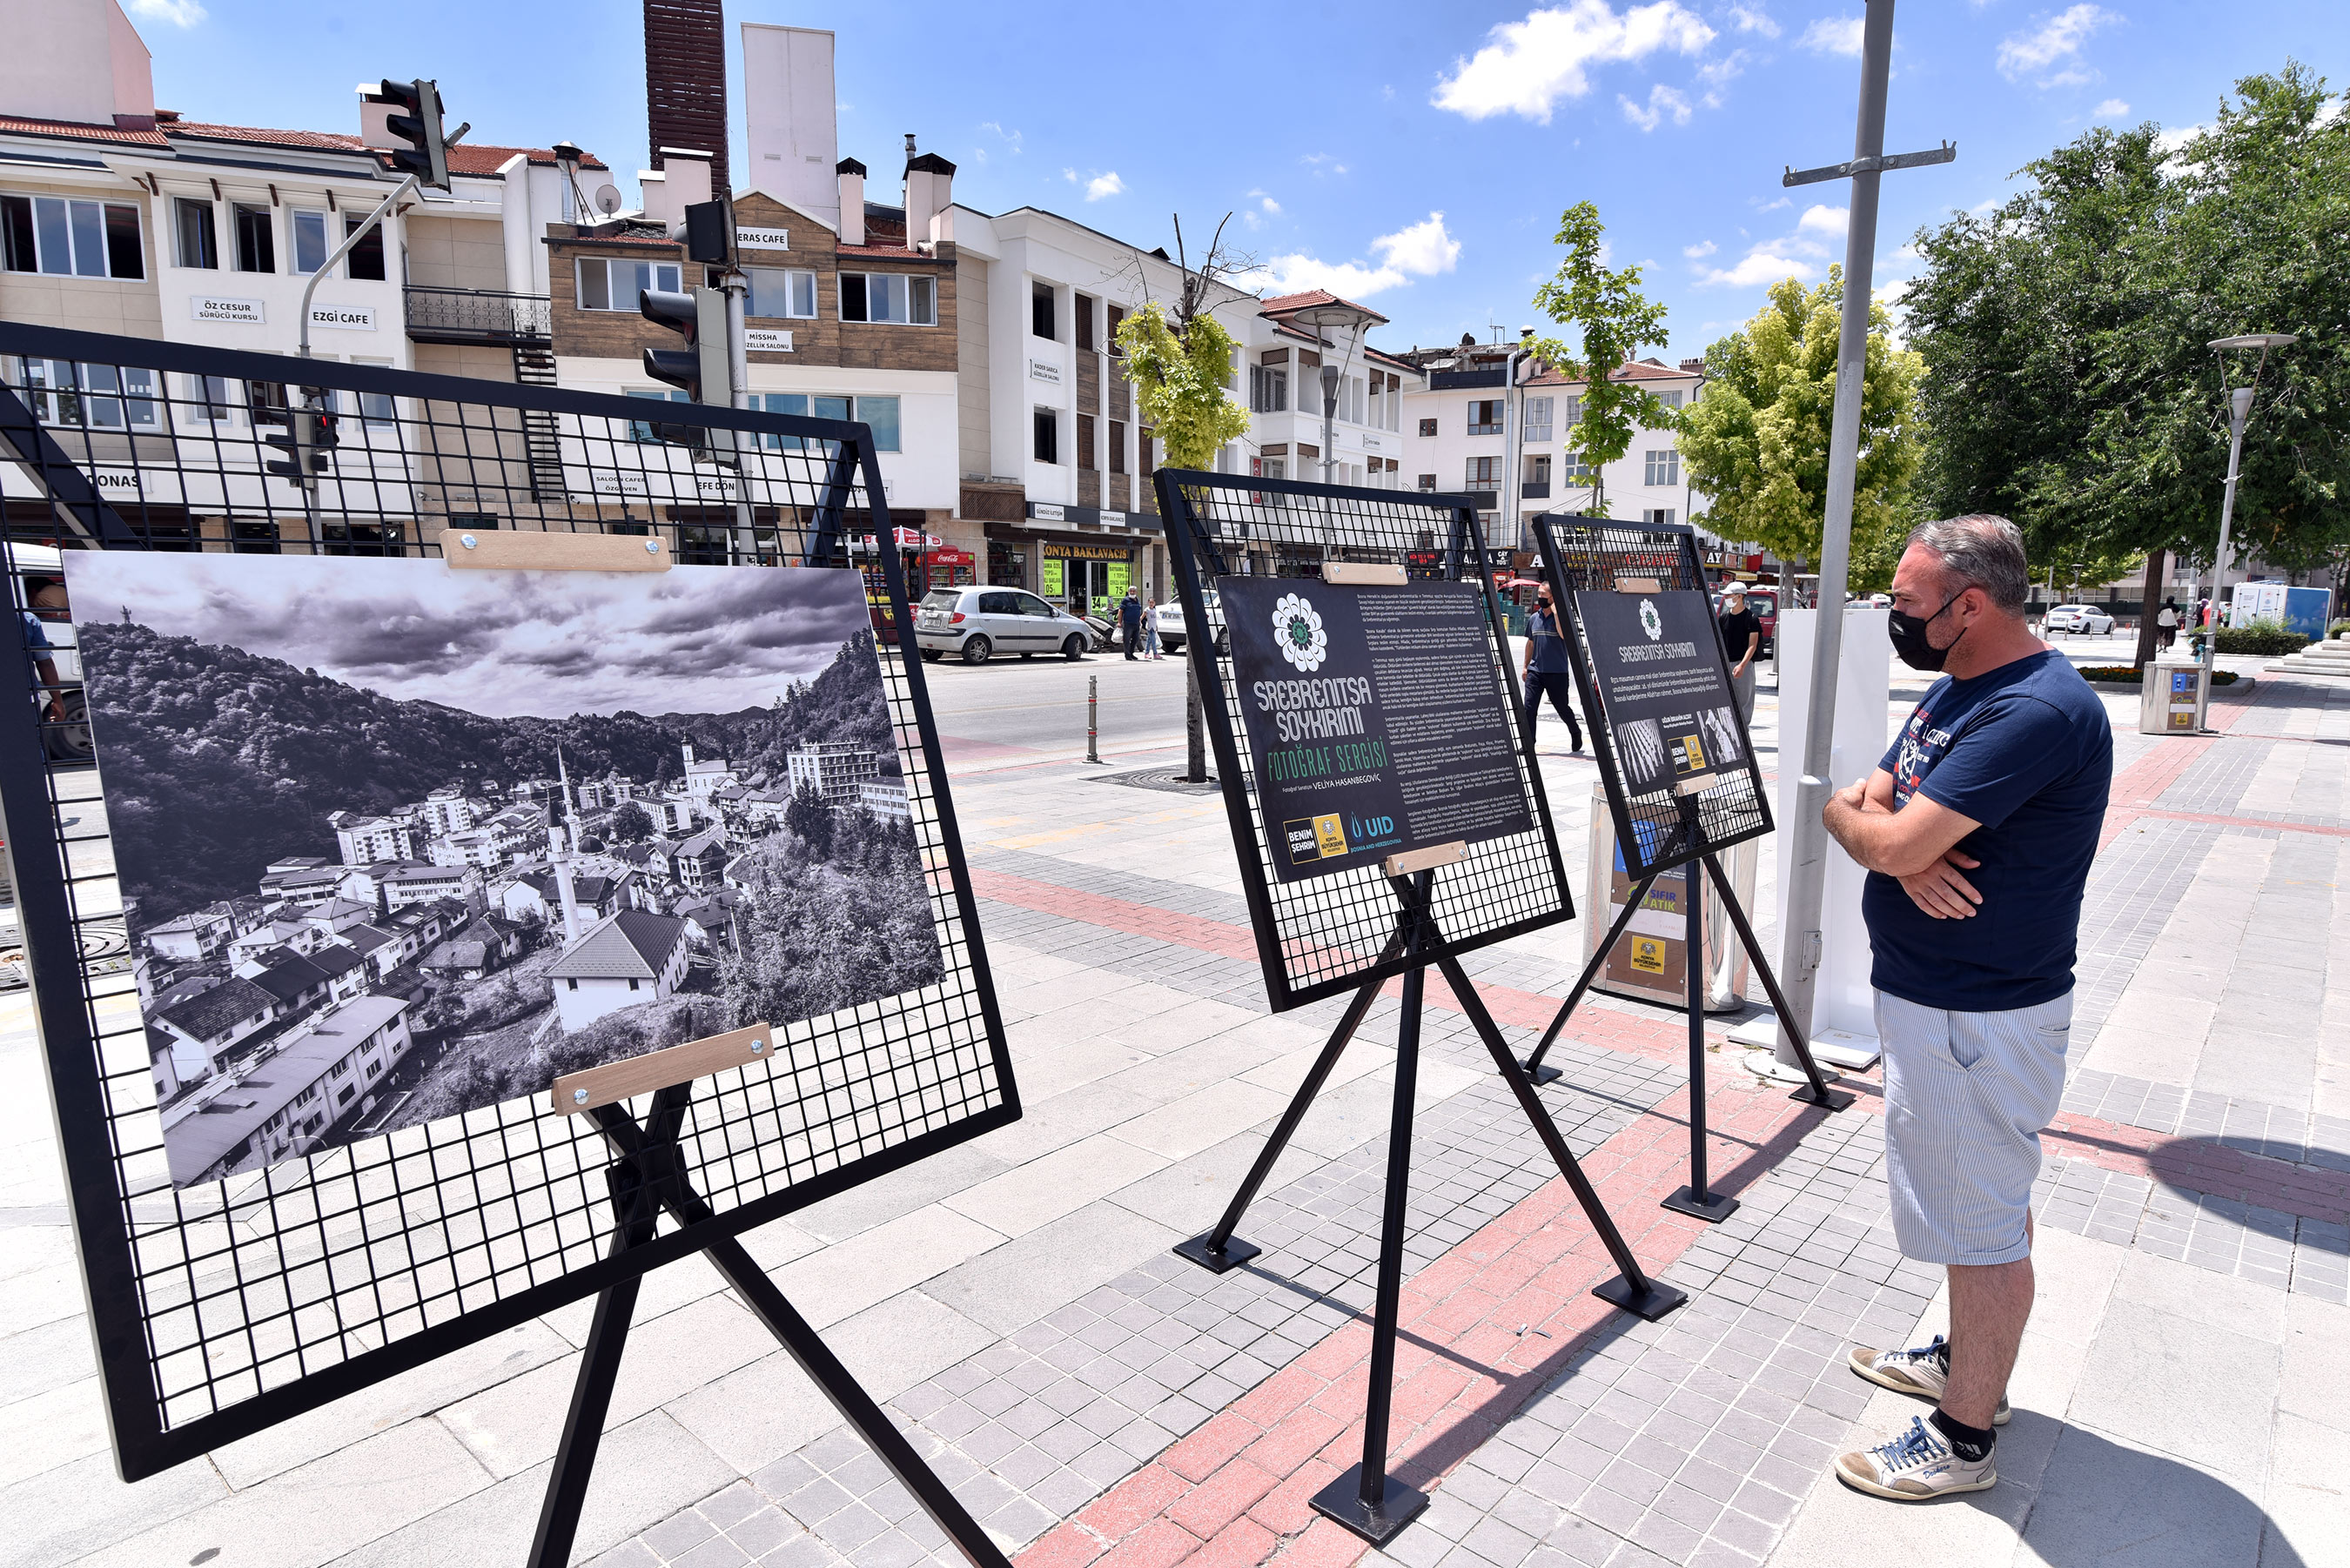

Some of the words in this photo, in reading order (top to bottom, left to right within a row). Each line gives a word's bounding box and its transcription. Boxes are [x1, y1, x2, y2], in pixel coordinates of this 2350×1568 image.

[762, 235, 785, 244] CAFE
[204, 300, 218, 310] ÖZ
[220, 303, 251, 312] CESUR
[199, 311, 231, 319] SÜRÜCÜ
[313, 310, 338, 322] EZGİ
[340, 313, 369, 324] CAFE
[749, 332, 777, 341] MİSSHA
[1073, 546, 1128, 559] BAKLAVACIS
[1115, 586, 1123, 594] 75
[1619, 644, 1665, 663] SREBRENITSA
[1253, 677, 1373, 711] SREBRENITSA
[1276, 707, 1365, 742] SOYKIRIMI
[1267, 744, 1332, 781] FOTOĞRAF
[1336, 735, 1388, 773] SERGİSİ
[1313, 777, 1336, 790] VELİYA
[1335, 772, 1382, 787] HASANBEGOVİÇ
[1365, 816, 1394, 837] UID
[1288, 828, 1313, 842] BENİM
[1291, 840, 1316, 854] ŞEHRİM
[1650, 889, 1676, 901] SIFIR
[1650, 899, 1676, 911] ATIK
